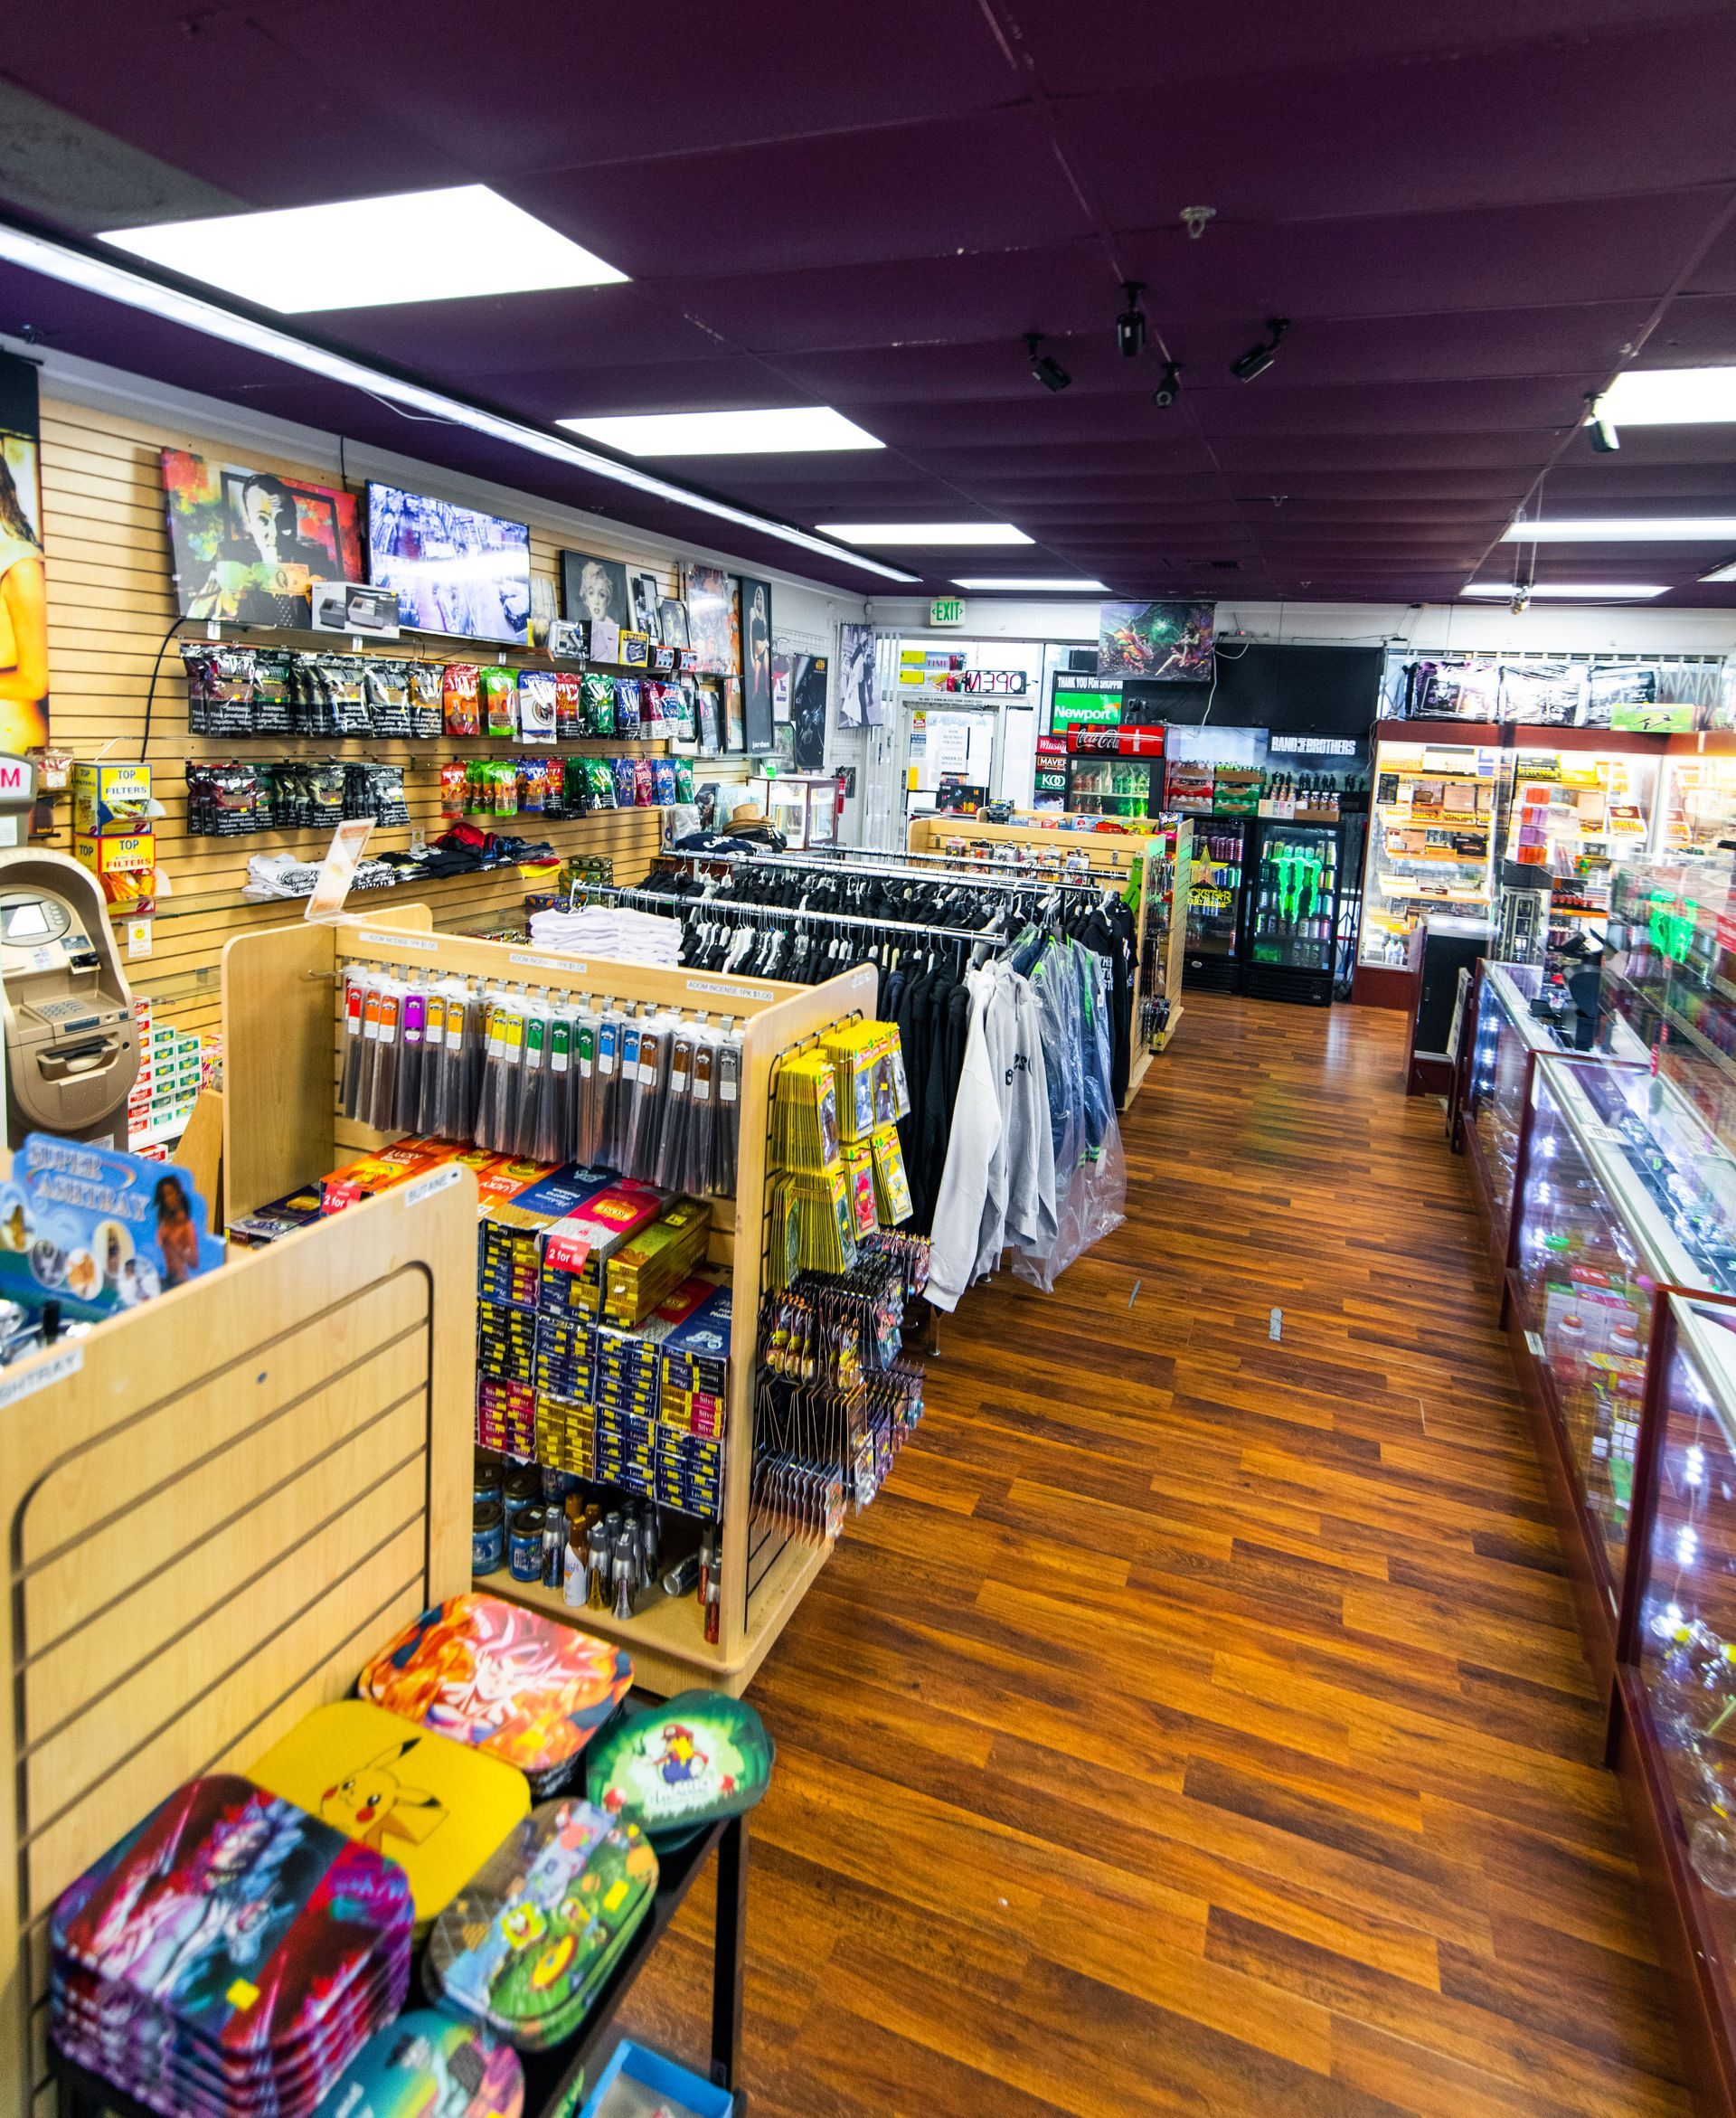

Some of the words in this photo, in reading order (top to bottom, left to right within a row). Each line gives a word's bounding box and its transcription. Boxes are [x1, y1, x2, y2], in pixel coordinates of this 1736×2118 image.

[936, 601, 960, 621] EXIT
[1058, 676, 1076, 689] THANK
[1076, 677, 1088, 689] YOU
[1054, 705, 1111, 722] Newport
[752, 740, 770, 750] jordan
[1271, 736, 1297, 752] BAND
[1306, 738, 1356, 756] BROTHERS
[80, 769, 90, 777] TOP
[118, 770, 136, 780] TOP
[106, 786, 146, 795] FILTERS
[80, 845, 93, 856] TOP
[119, 839, 139, 851] TOP
[107, 857, 151, 869] FILTERS
[385, 937, 407, 947] INCENSE
[420, 941, 436, 950] $1.00
[511, 954, 528, 963] ADOM
[568, 962, 586, 972] $1.00
[688, 981, 708, 991] ADOM
[709, 984, 739, 995] INCENSE
[740, 988, 752, 998] 1PK
[753, 989, 772, 1000] $1.00
[28, 1141, 103, 1181] SUPER
[387, 1149, 424, 1160] LUCKY
[409, 1174, 448, 1203] BUTANE
[37, 1172, 150, 1222] ASHTRAY
[324, 1196, 331, 1205] 2
[332, 1196, 345, 1208] for
[548, 1248, 555, 1260] 2
[557, 1248, 571, 1262] for
[698, 1409, 715, 1419] Silve
